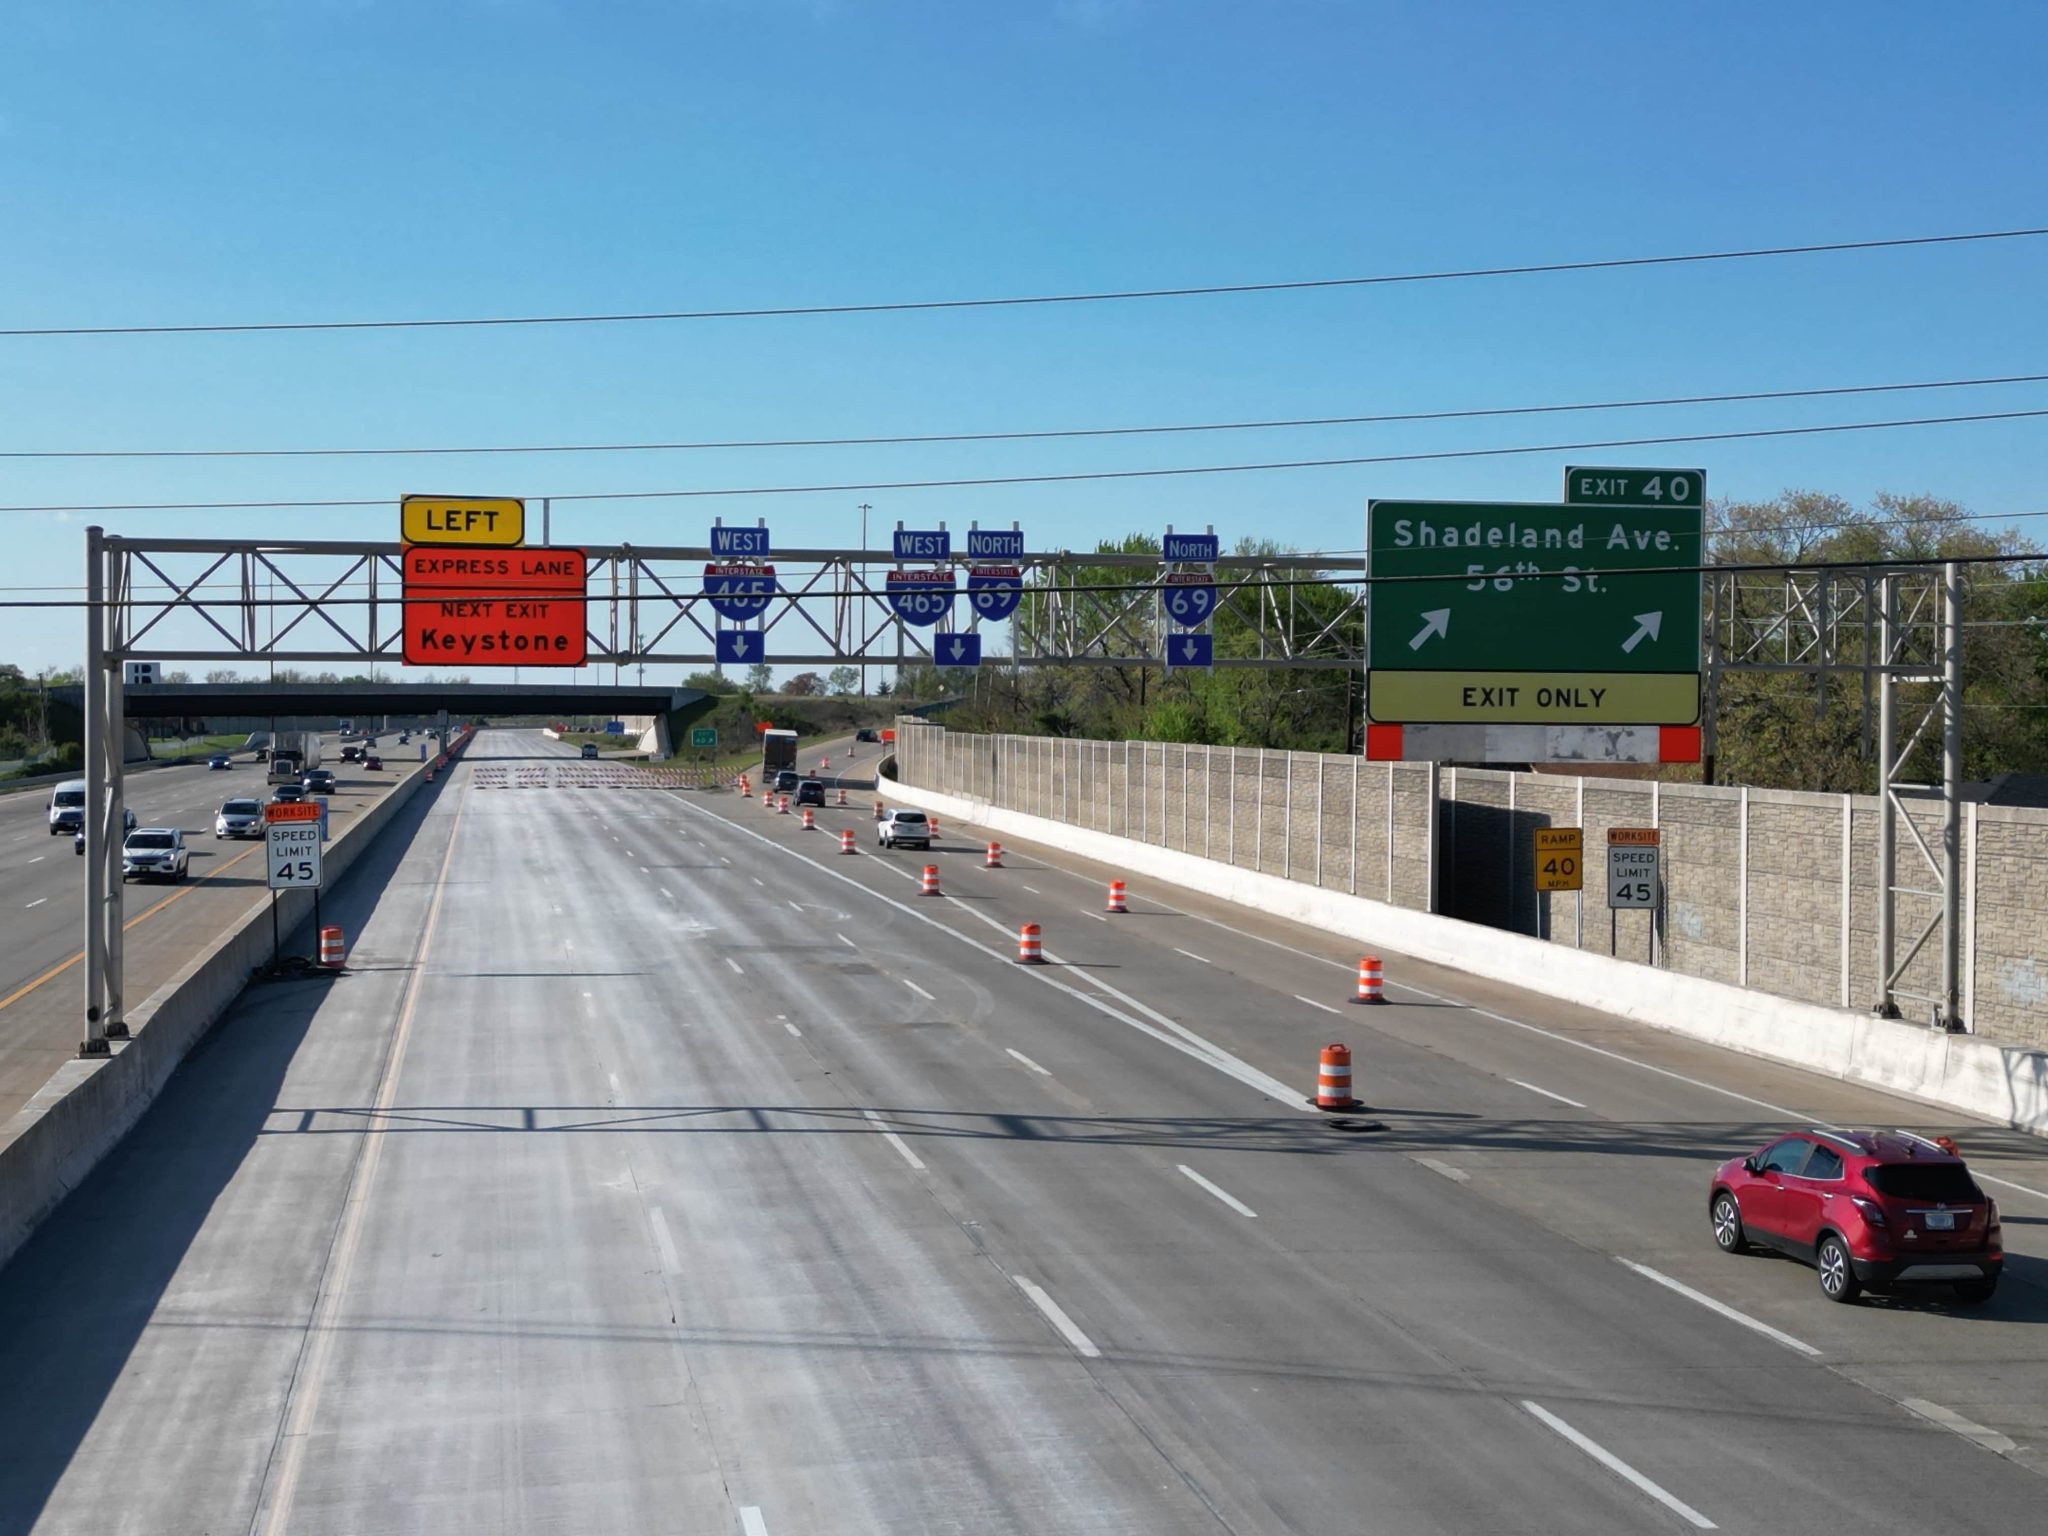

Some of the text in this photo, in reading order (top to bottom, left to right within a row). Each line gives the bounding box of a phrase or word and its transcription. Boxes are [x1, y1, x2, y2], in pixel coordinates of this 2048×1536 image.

[1581, 476, 1690, 501] EXIT 40
[426, 509, 499, 532] LEFT
[717, 531, 763, 551] WEST
[970, 535, 1021, 554] NORTH
[1394, 519, 1680, 551] Shadeland Ave.
[899, 535, 945, 555] WEST
[1169, 540, 1213, 558] NORTH
[414, 559, 575, 576] EXPRESS LANE
[715, 566, 765, 576] INTERSTATE
[892, 572, 951, 582] INTERSTATE
[976, 567, 1015, 577] INTERSTATE
[1466, 561, 1608, 593] 56th St.
[714, 580, 766, 608] 465
[898, 587, 946, 614] 465
[976, 582, 1013, 609] 69
[1171, 588, 1210, 615] 69
[441, 601, 549, 619] NEXT EXIT
[421, 628, 569, 656] Keystone
[1462, 687, 1608, 708] EXIT ONLY
[267, 804, 319, 818] WORKSITE
[272, 830, 317, 842] SPEED
[1541, 834, 1576, 845] RAMP
[1610, 831, 1658, 842] WORKSITE
[276, 846, 312, 858] LIMIT
[1613, 852, 1655, 864] SPEED
[276, 861, 314, 881] 45
[1543, 857, 1575, 876] 40
[1616, 868, 1651, 878] LIMIT
[1616, 883, 1651, 902] 45
